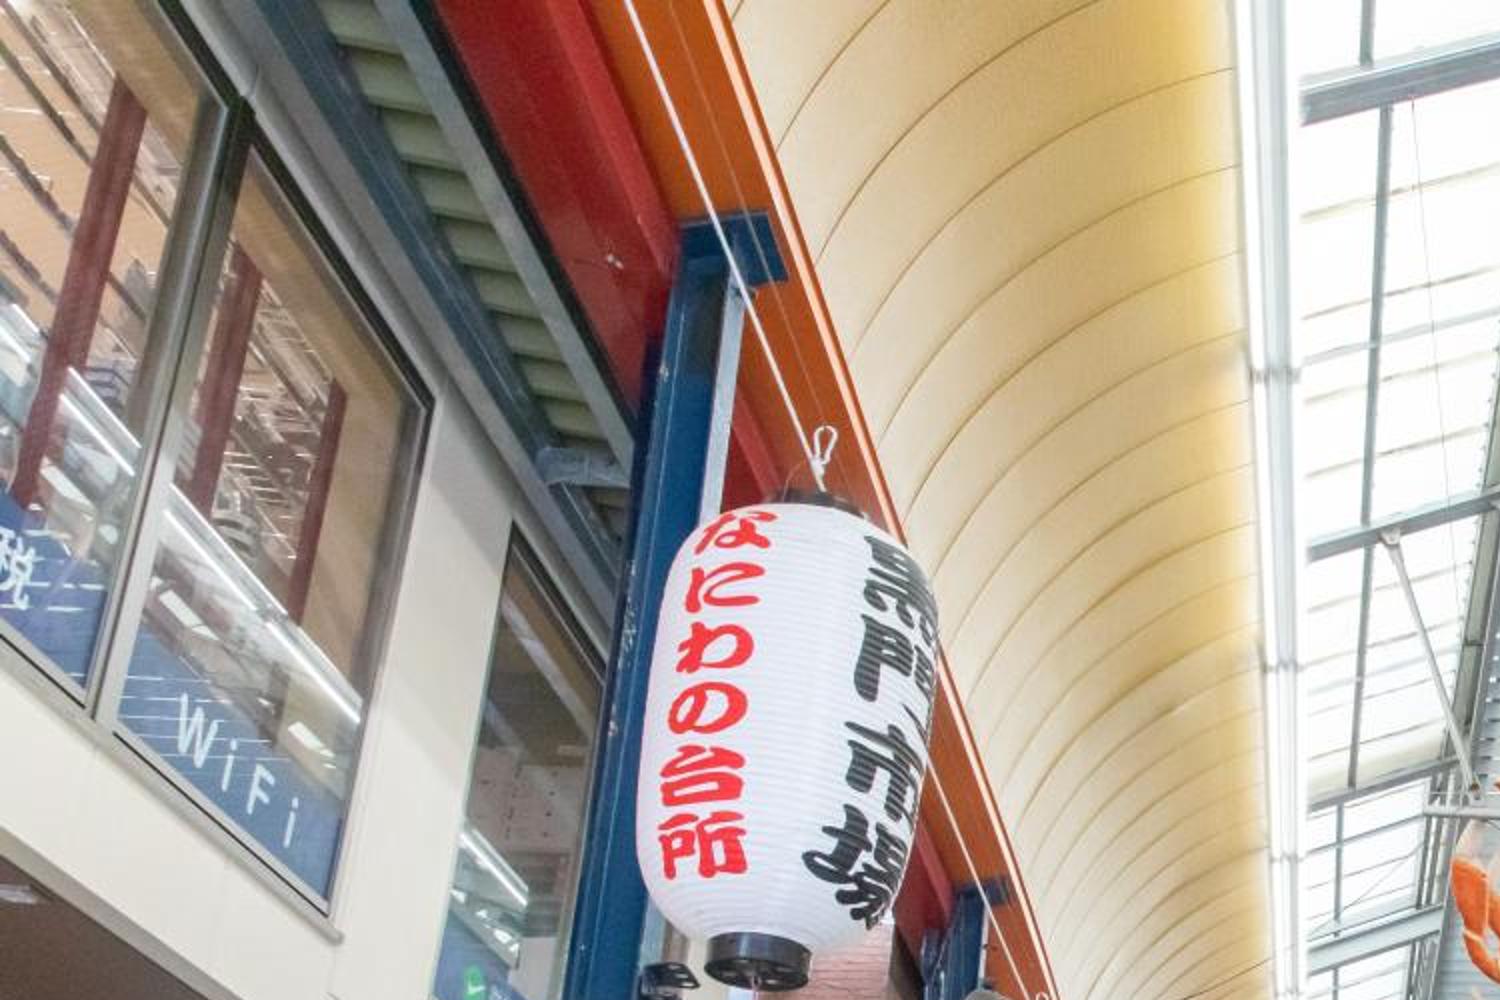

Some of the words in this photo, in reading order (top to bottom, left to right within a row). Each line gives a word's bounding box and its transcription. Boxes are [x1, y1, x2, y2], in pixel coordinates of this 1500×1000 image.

[175, 691, 299, 848] WiFi
[657, 510, 777, 880] なにわの台所
